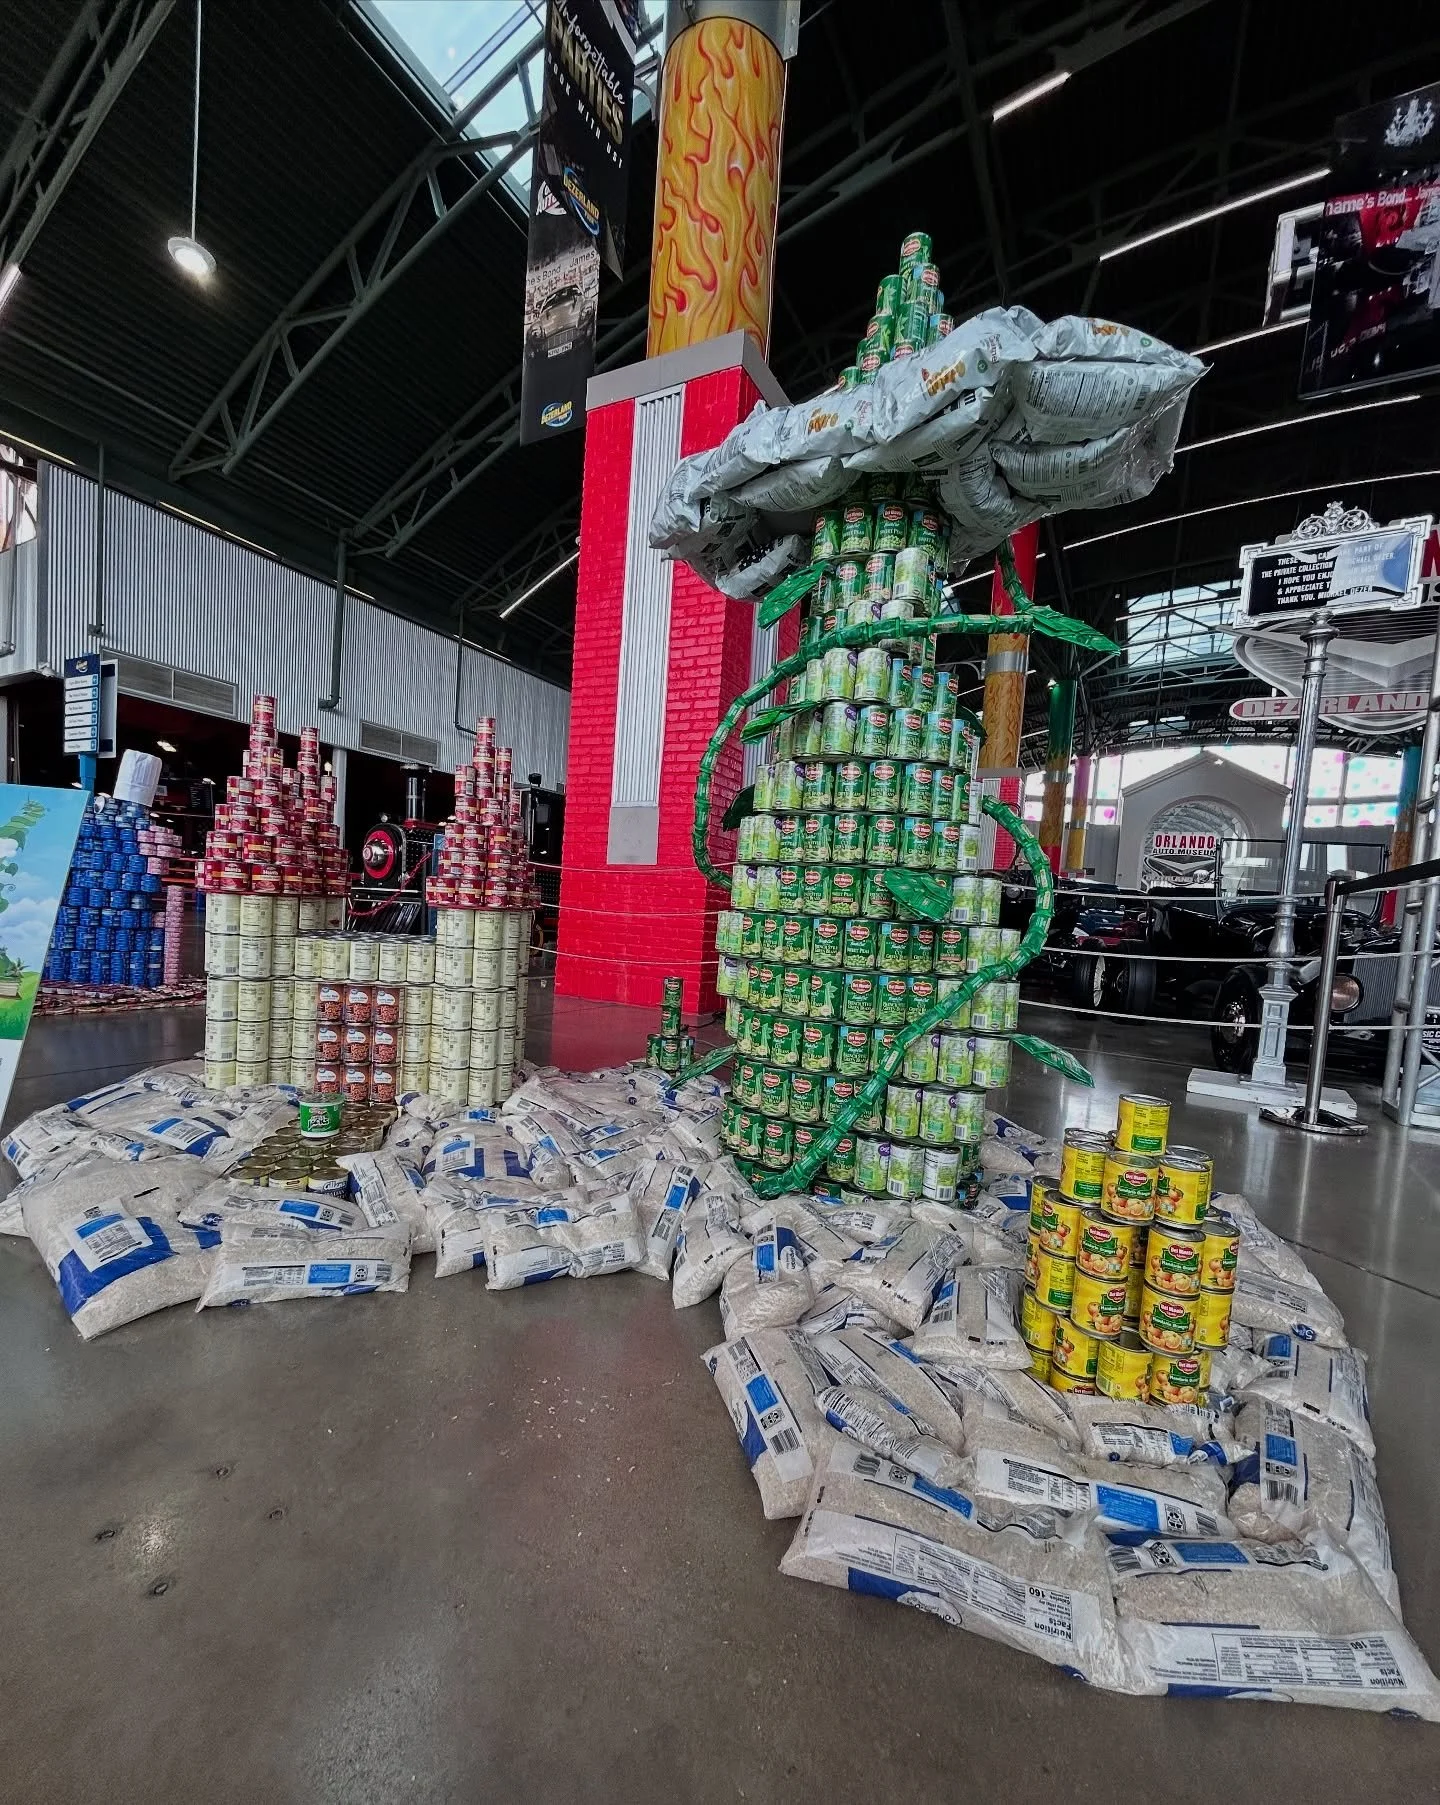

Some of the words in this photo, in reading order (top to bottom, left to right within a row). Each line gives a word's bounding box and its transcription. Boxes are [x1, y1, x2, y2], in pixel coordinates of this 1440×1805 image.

[555, 0, 625, 104] nforgettable
[550, 2, 624, 144] PARTIES
[563, 173, 600, 221] DEZERLAND
[1261, 570, 1273, 579] THE
[1273, 566, 1297, 577] PRIVATE
[1298, 560, 1335, 572] COLLECTION
[1283, 575, 1301, 585] HOPE
[1302, 573, 1316, 582] YOU
[1317, 570, 1334, 580] ENJO
[1285, 581, 1324, 595] APPRECIATE
[1276, 595, 1299, 605] THANK
[1242, 692, 1430, 718] DEZRLAND
[1155, 834, 1216, 850] ORLANDO
[1161, 1260, 1182, 1269] Mandarin
[1152, 1317, 1172, 1327] Mandarin
[1029, 1586, 1046, 1599] 160
[1034, 1622, 1072, 1640] Nutrition
[1048, 1617, 1072, 1631] Facts
[1350, 1641, 1368, 1650] 160
[1379, 1668, 1401, 1677] Facts
[1369, 1678, 1405, 1688] Nutrition
